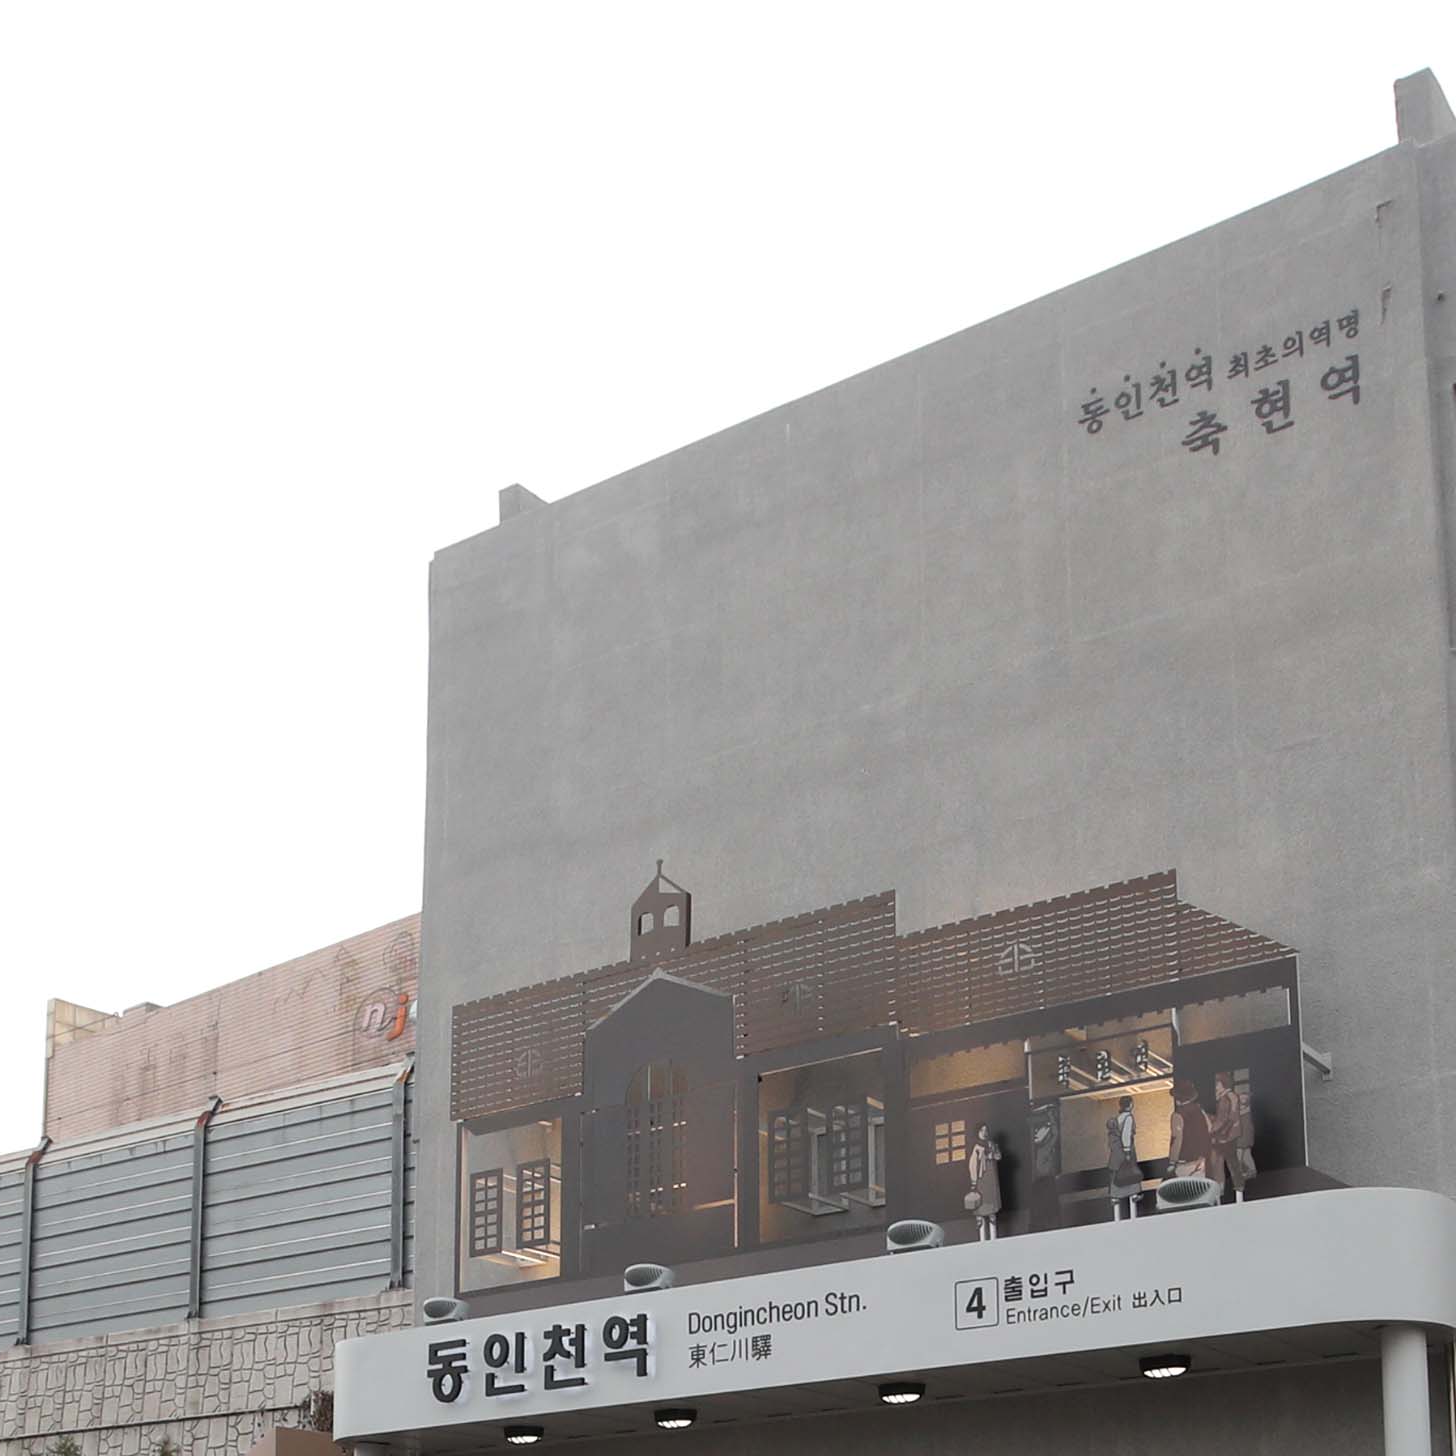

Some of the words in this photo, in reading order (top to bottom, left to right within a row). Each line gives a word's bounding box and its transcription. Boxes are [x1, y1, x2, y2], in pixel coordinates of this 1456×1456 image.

[1078, 347, 1213, 434] 동인천역
[1181, 354, 1360, 456] 축현역
[965, 1287, 986, 1319] 4
[1003, 1269, 1075, 1302] 출입구
[1006, 1295, 1122, 1325] Entrance/Exit
[1131, 1287, 1183, 1309] 出入口
[688, 1299, 818, 1335] Dongincheon
[824, 1291, 867, 1317] Stn.
[427, 1313, 649, 1403] 동인천역
[688, 1333, 772, 1369] 東仁川驛
